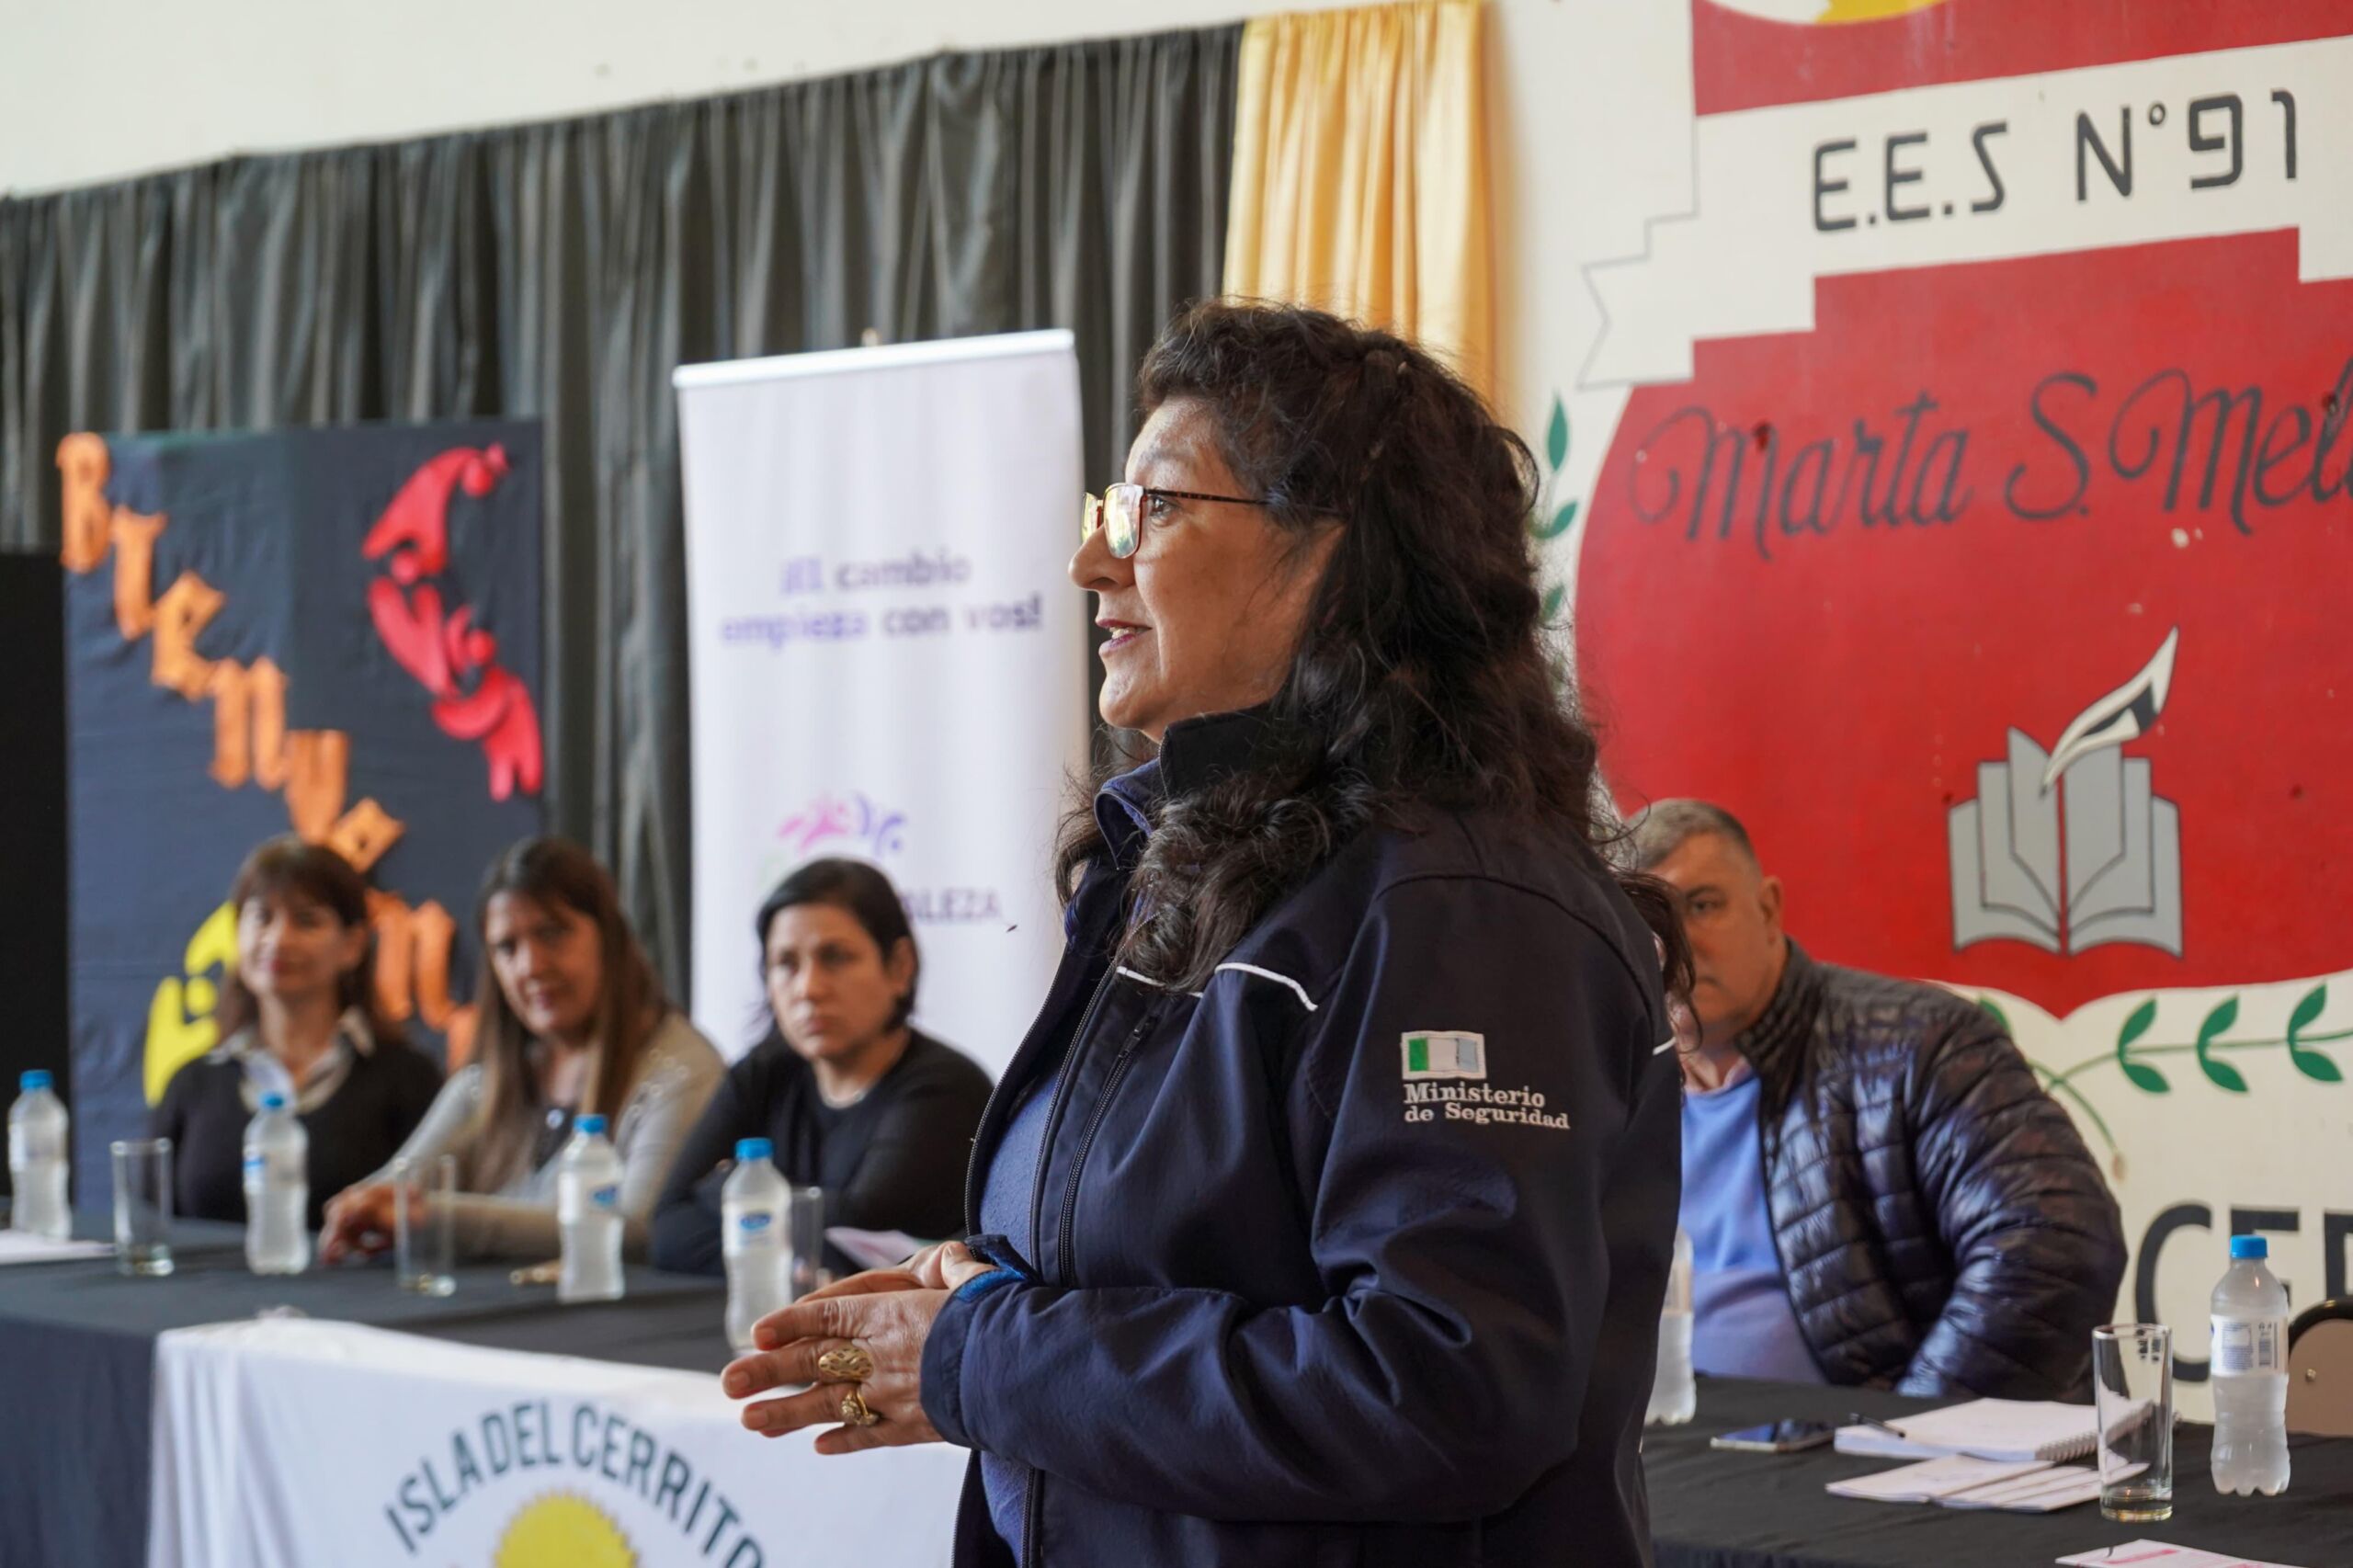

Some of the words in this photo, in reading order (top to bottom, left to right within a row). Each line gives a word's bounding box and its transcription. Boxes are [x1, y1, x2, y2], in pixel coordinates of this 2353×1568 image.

[1813, 120, 2008, 233] E.E.S
[1630, 390, 1972, 562] Marta
[2005, 371, 2098, 520] S.
[2108, 356, 2353, 536] Mel
[834, 546, 972, 590] cambio
[719, 606, 870, 652] empieza
[882, 606, 949, 637] con
[1403, 1081, 1546, 1108] Ministerio
[1404, 1106, 1435, 1122] de
[1444, 1101, 1571, 1130] Seguridad
[385, 1426, 485, 1556] ISLA
[479, 1398, 561, 1478] DEL
